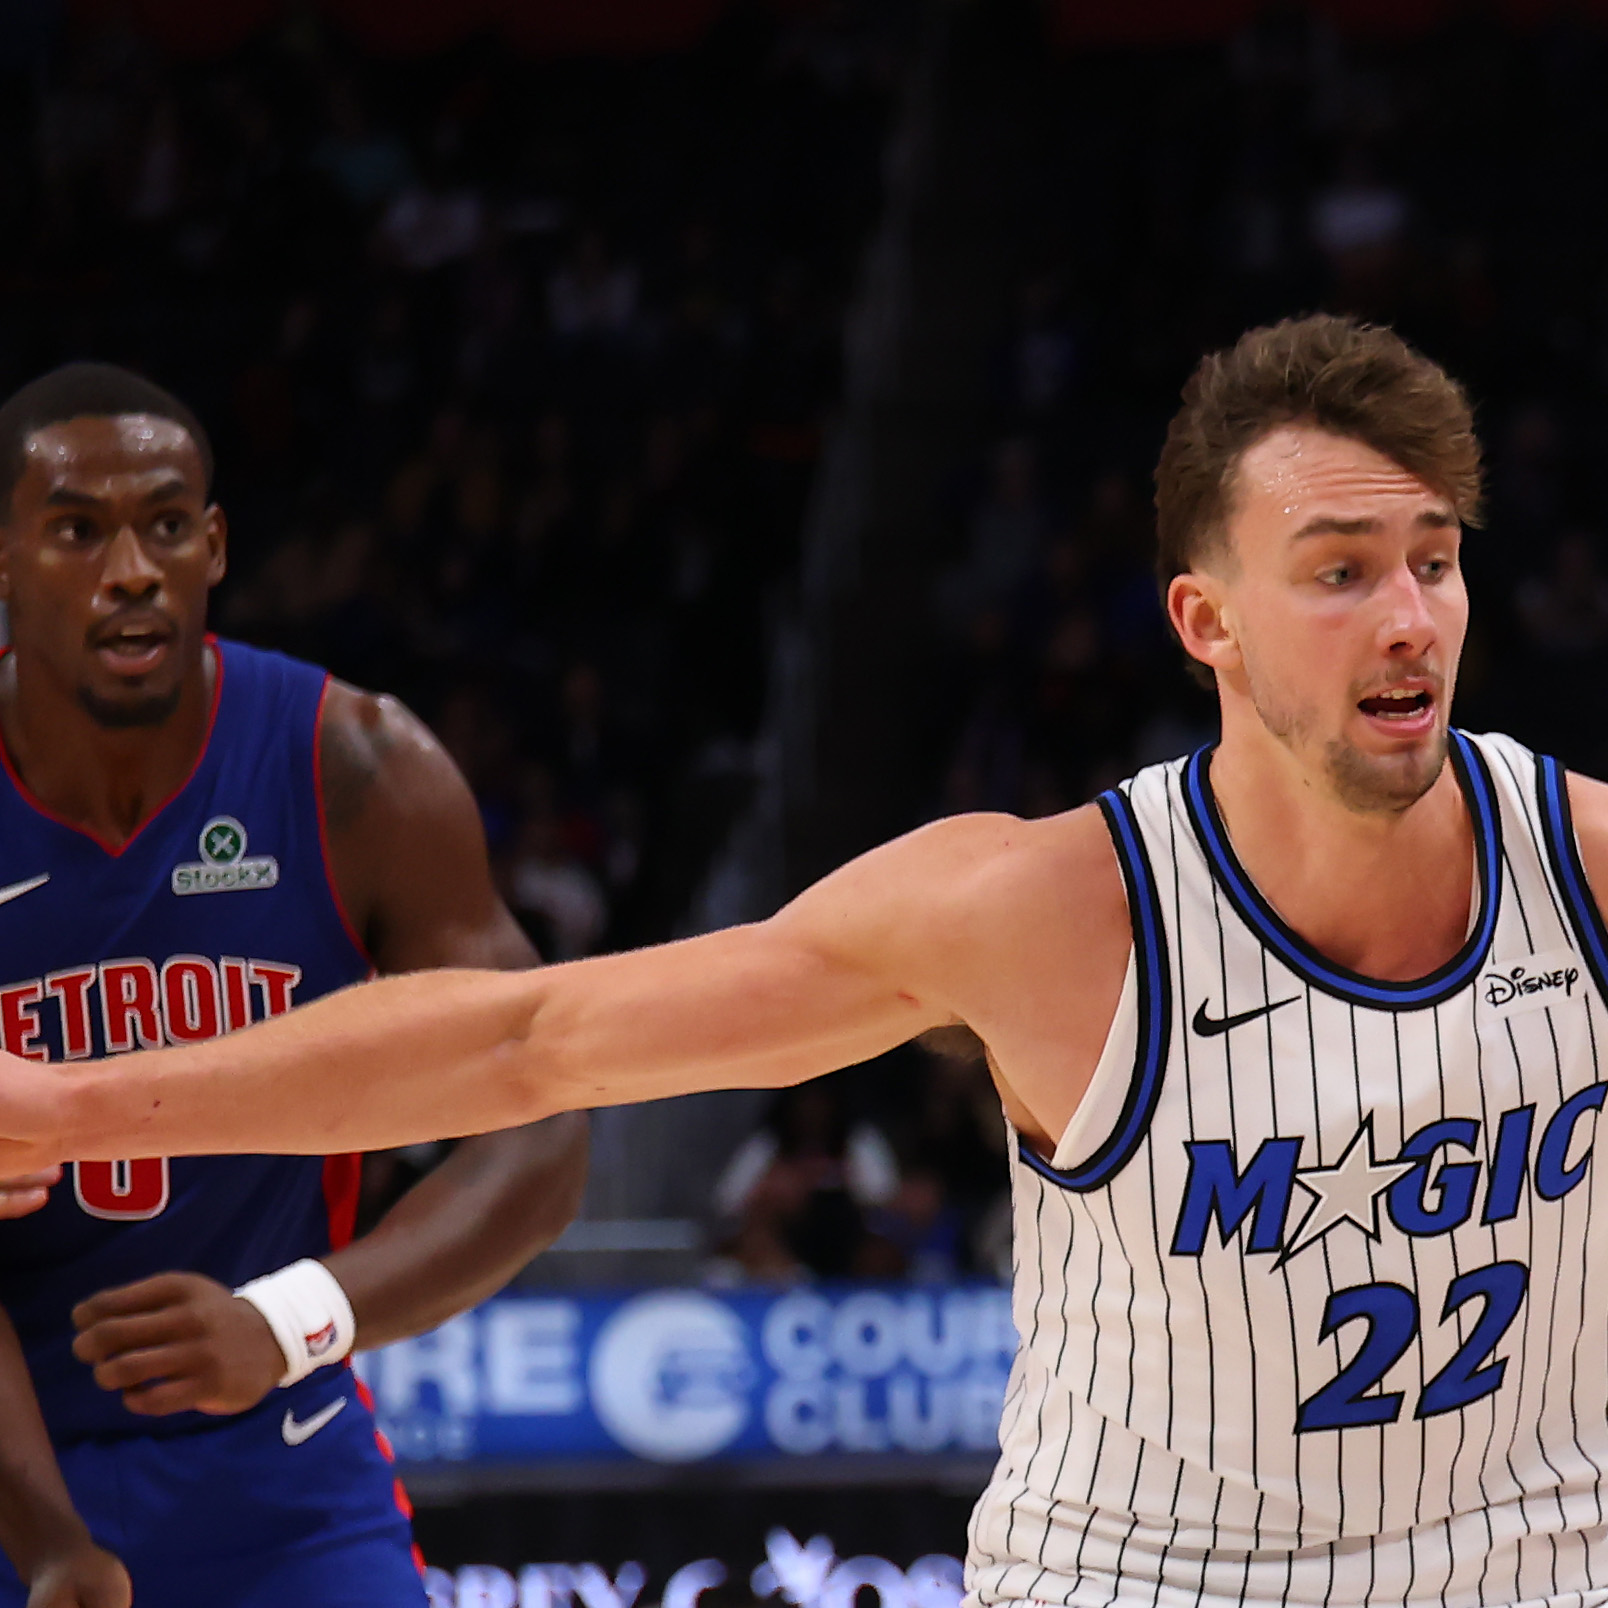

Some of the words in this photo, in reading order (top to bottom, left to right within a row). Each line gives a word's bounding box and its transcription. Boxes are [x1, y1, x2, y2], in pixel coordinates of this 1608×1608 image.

[0, 953, 302, 1063] ETROIT
[352, 1300, 582, 1415] RE
[1293, 1260, 1530, 1435] 22
